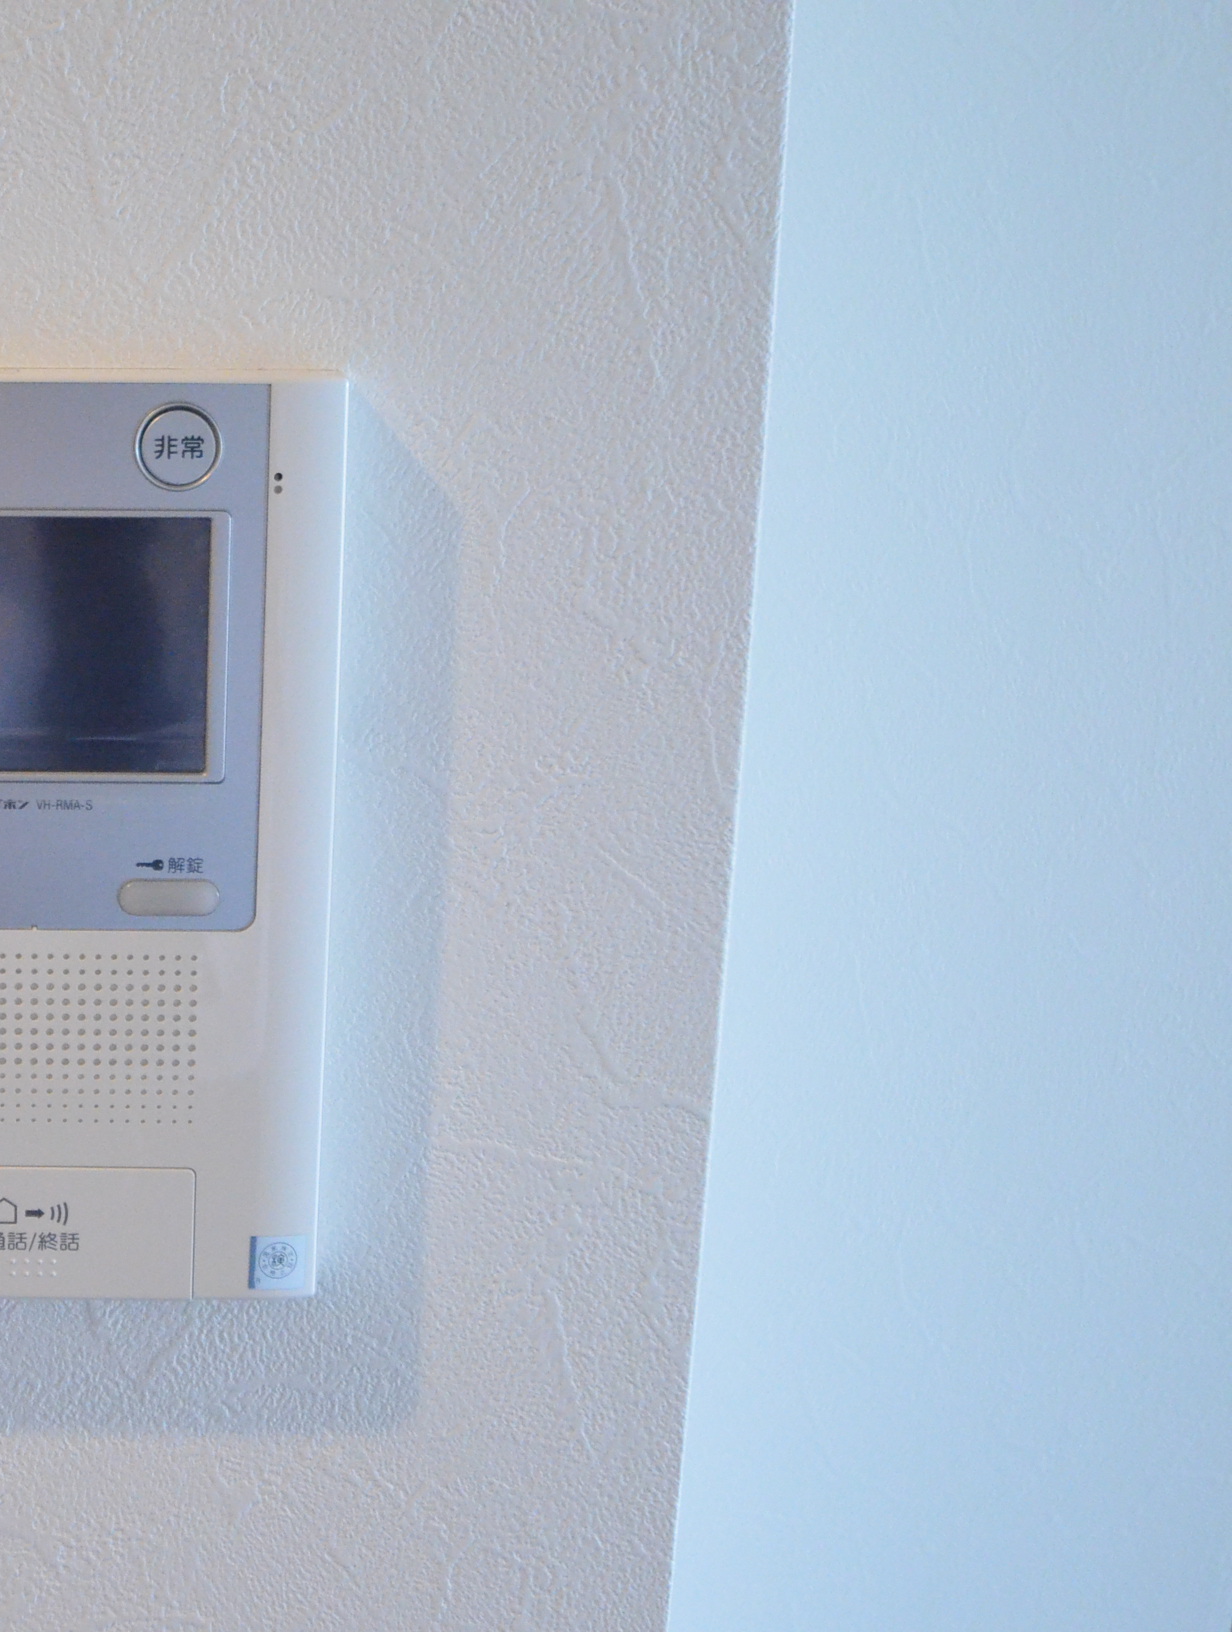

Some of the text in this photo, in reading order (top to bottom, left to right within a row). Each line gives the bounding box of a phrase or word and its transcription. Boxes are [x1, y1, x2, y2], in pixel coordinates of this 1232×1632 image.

[154, 435, 204, 460] 非常
[36, 799, 93, 810] VH-RMA-S
[167, 857, 204, 874] 解錠
